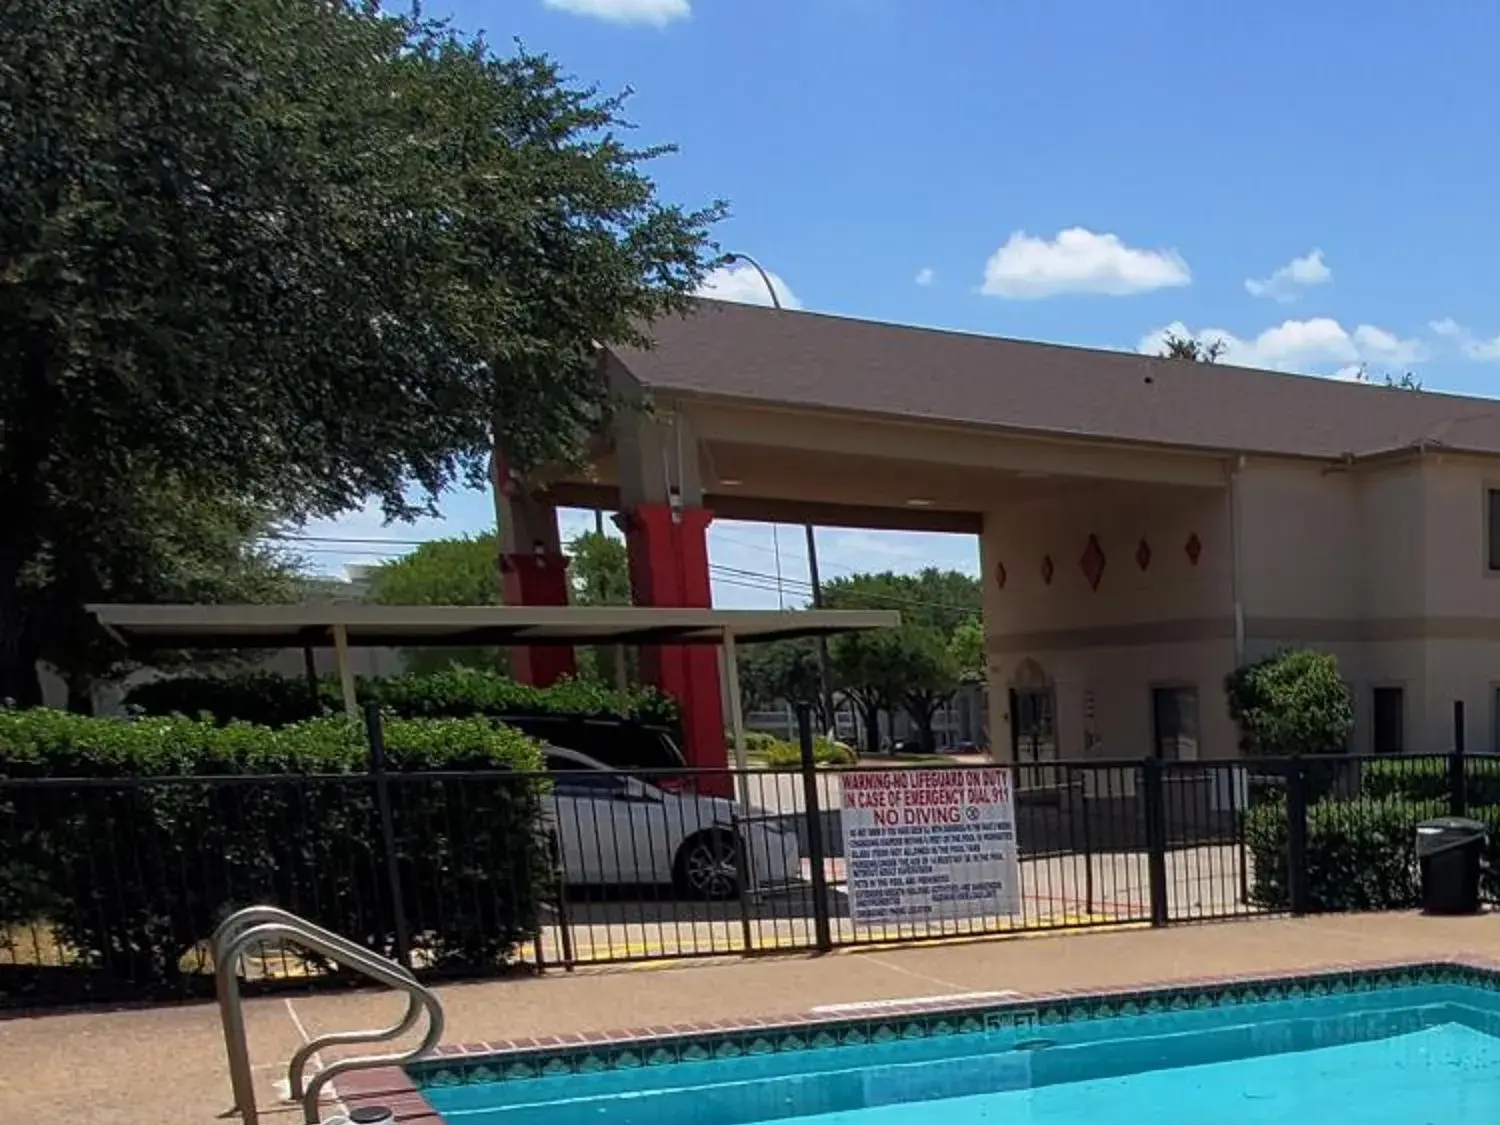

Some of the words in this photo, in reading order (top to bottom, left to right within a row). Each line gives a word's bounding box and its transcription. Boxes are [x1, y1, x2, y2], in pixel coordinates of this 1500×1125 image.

[910, 771, 964, 788] LIFEGUARD
[966, 771, 981, 786] ON
[983, 770, 1007, 785] DUTY
[858, 790, 887, 808] CASE
[888, 789, 903, 806] OF
[904, 787, 965, 806] EMERGENCY
[874, 808, 899, 825] NO
[903, 806, 961, 824] DIVING
